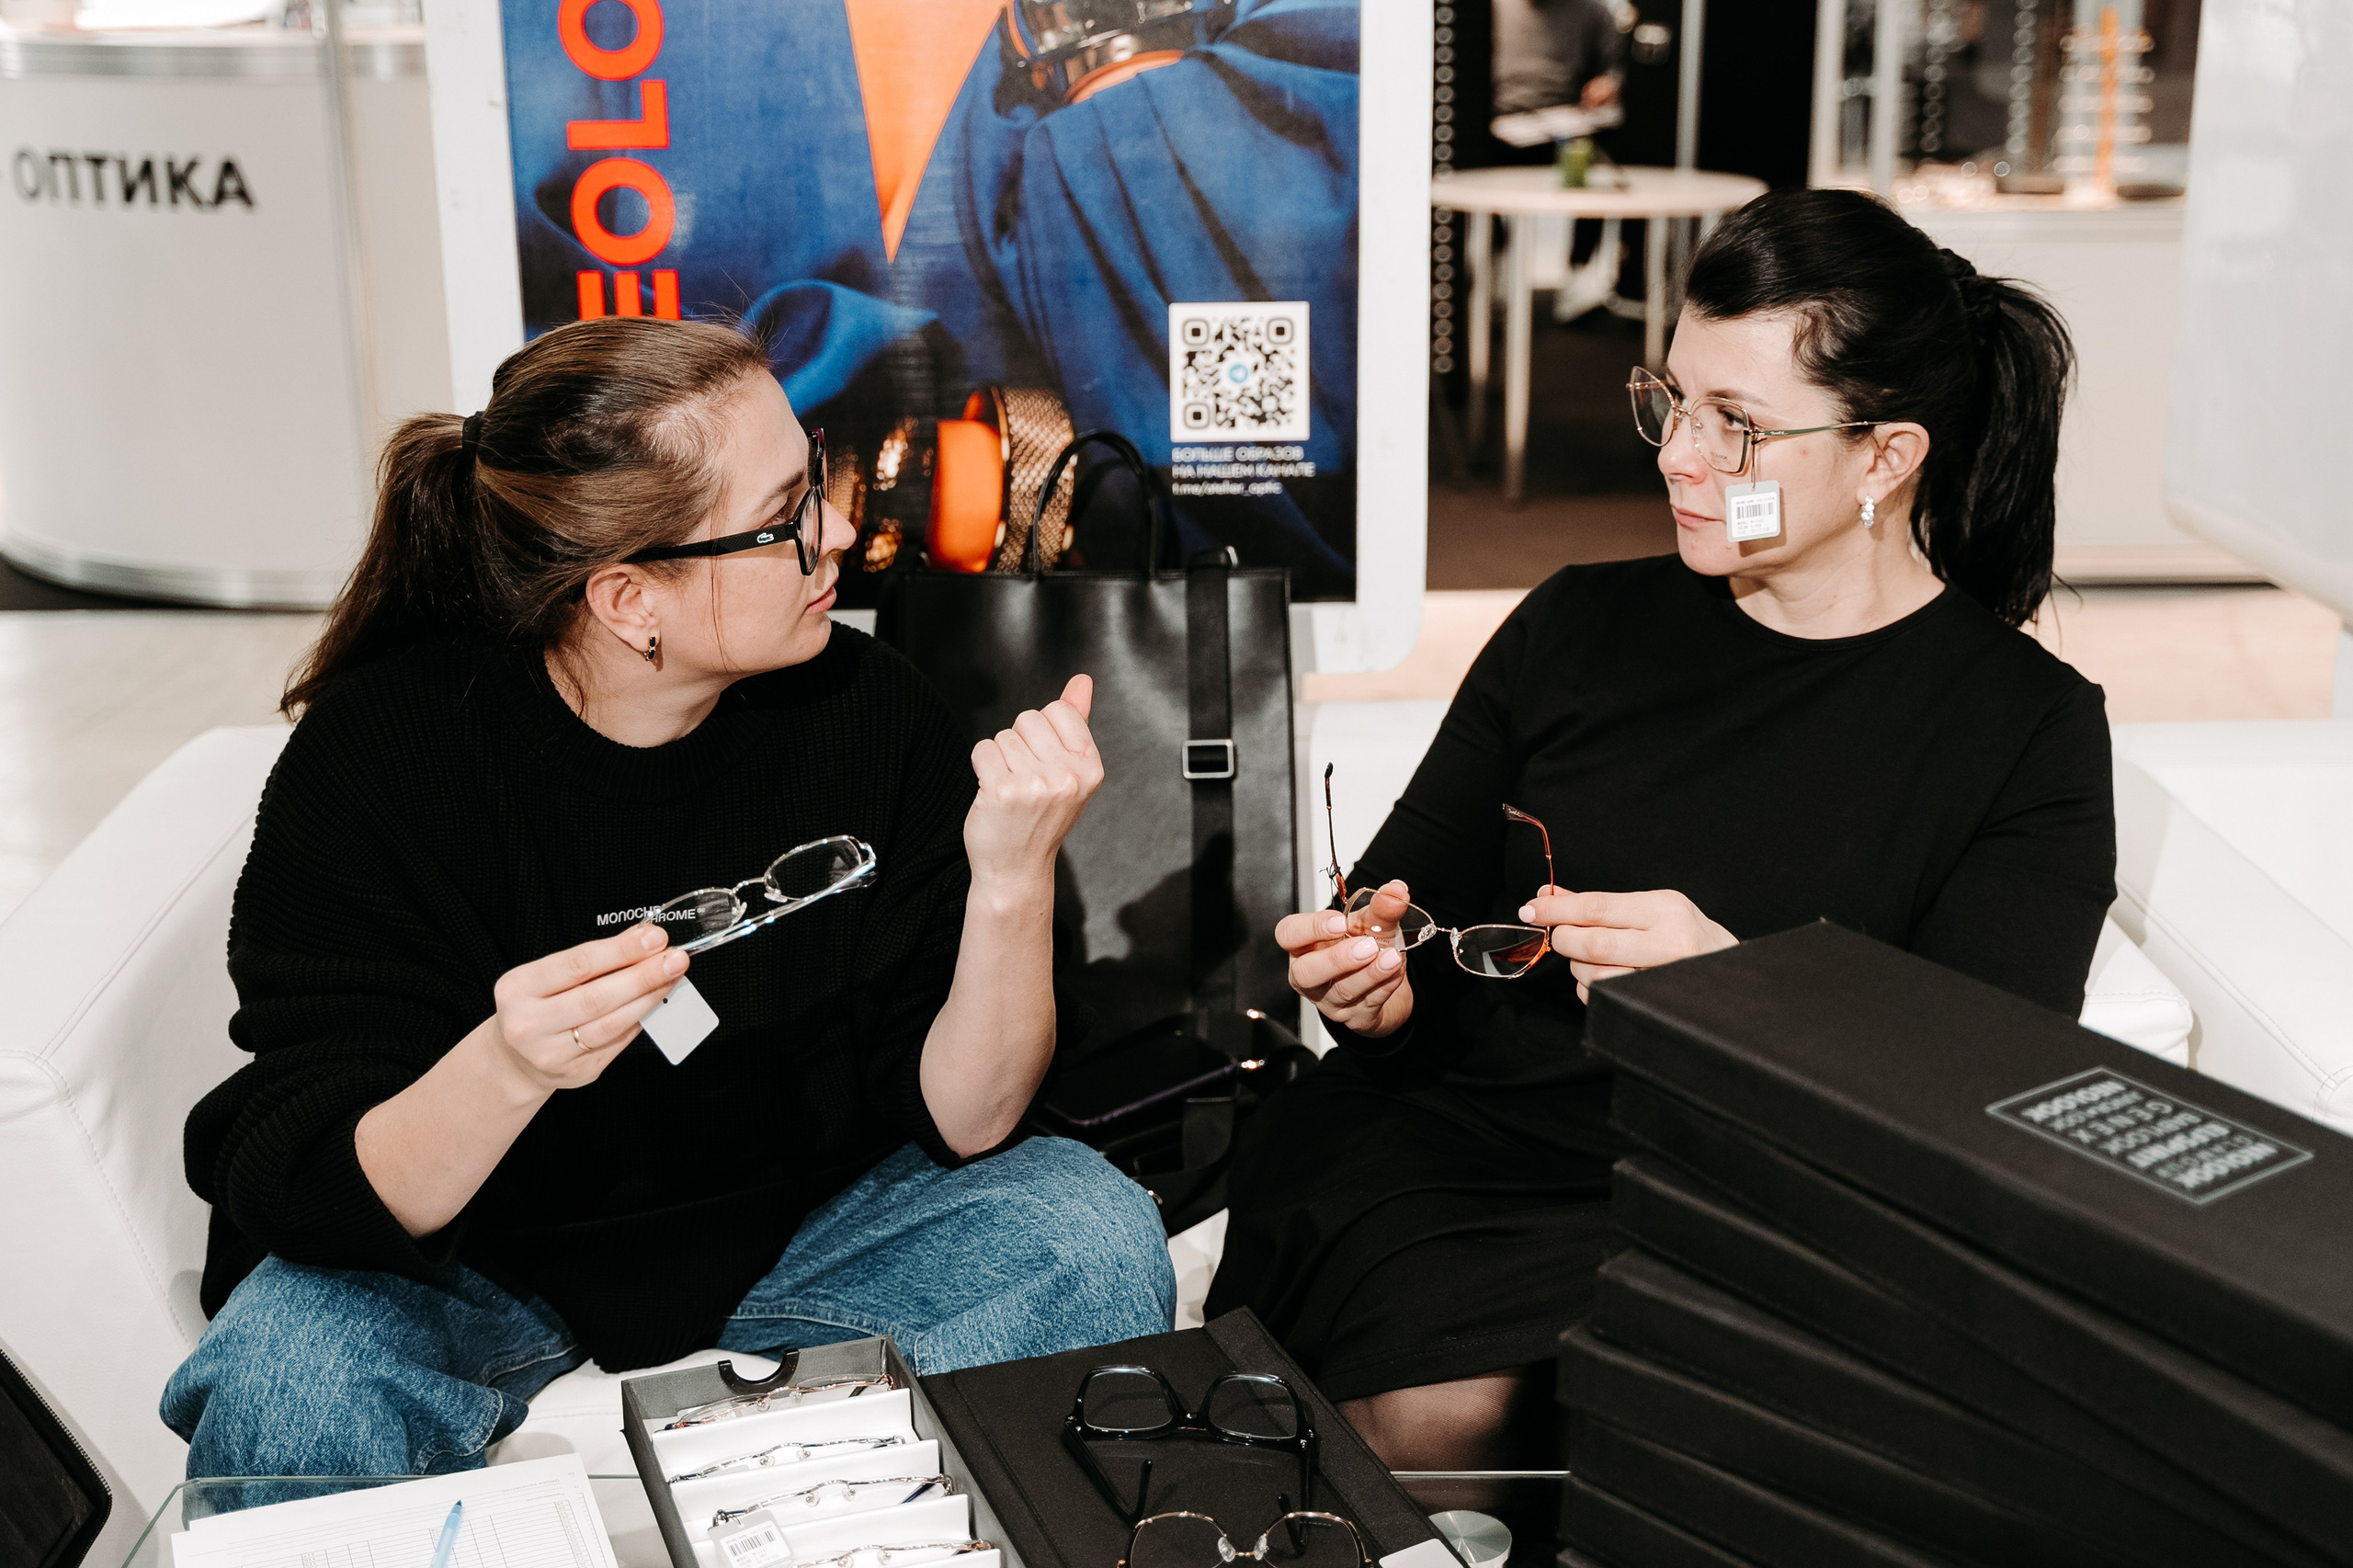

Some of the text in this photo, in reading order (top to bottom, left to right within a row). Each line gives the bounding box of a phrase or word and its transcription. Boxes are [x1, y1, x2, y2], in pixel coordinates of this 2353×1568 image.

[13, 147, 258, 210] ОПТИКА
[1171, 446, 1305, 462] БОЛЬШЕ ОБРАЗОВ
[1172, 461, 1317, 478] НА НАШЕМ КАНАЛЕ
[2019, 1079, 2127, 1122] NEOLOOK
[2068, 1098, 2175, 1144] GENEX
[2176, 1142, 2279, 1189] NEOLOOK
